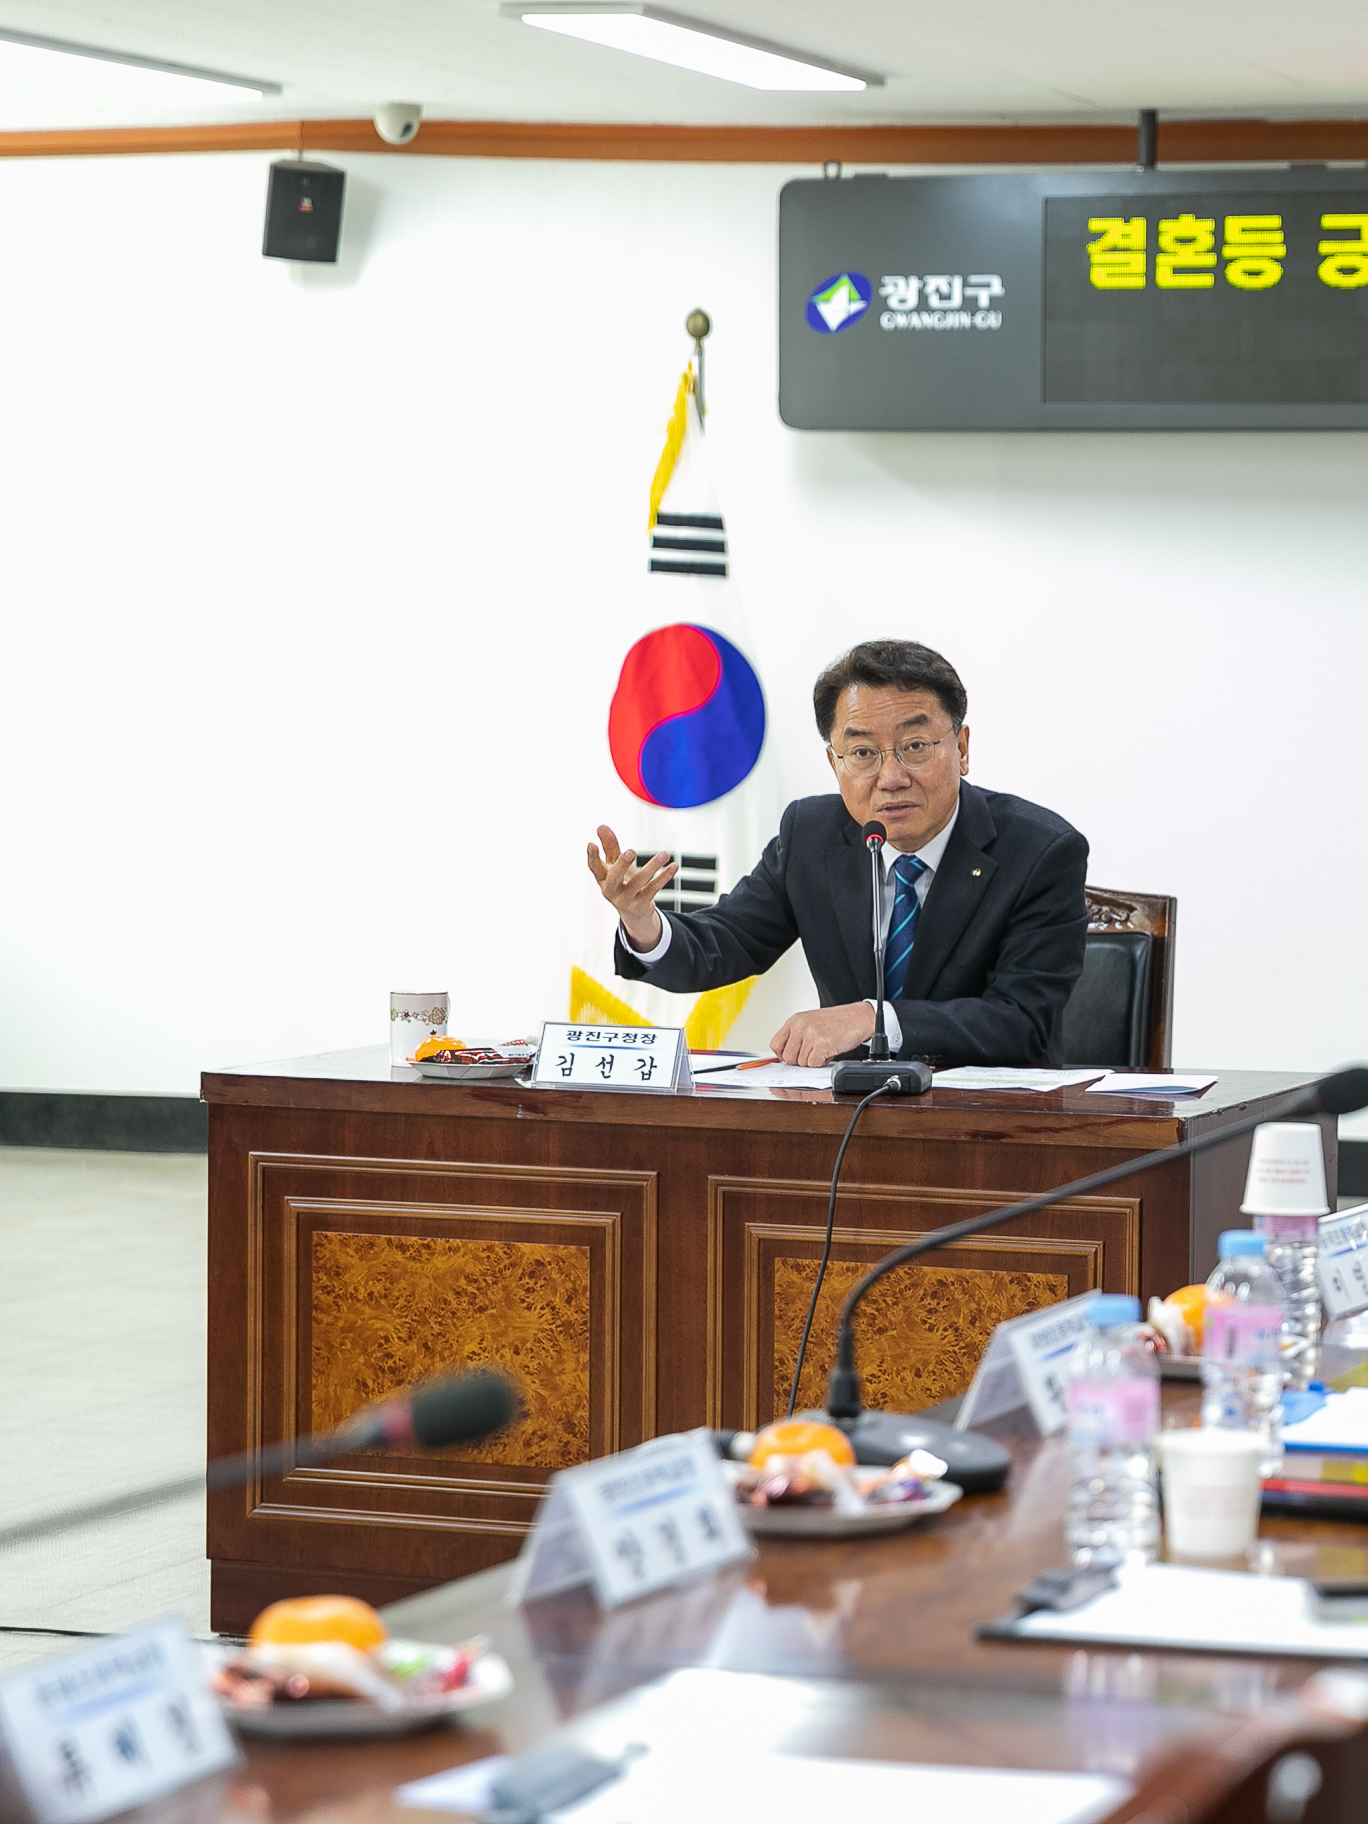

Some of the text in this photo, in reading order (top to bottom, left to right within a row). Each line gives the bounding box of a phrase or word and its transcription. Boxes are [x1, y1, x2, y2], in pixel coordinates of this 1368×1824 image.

[1086, 214, 1286, 290] 결혼등
[878, 274, 1005, 310] 광진구
[880, 310, 1003, 331] GWANGJIN-GU
[566, 1029, 658, 1044] 광진구청장
